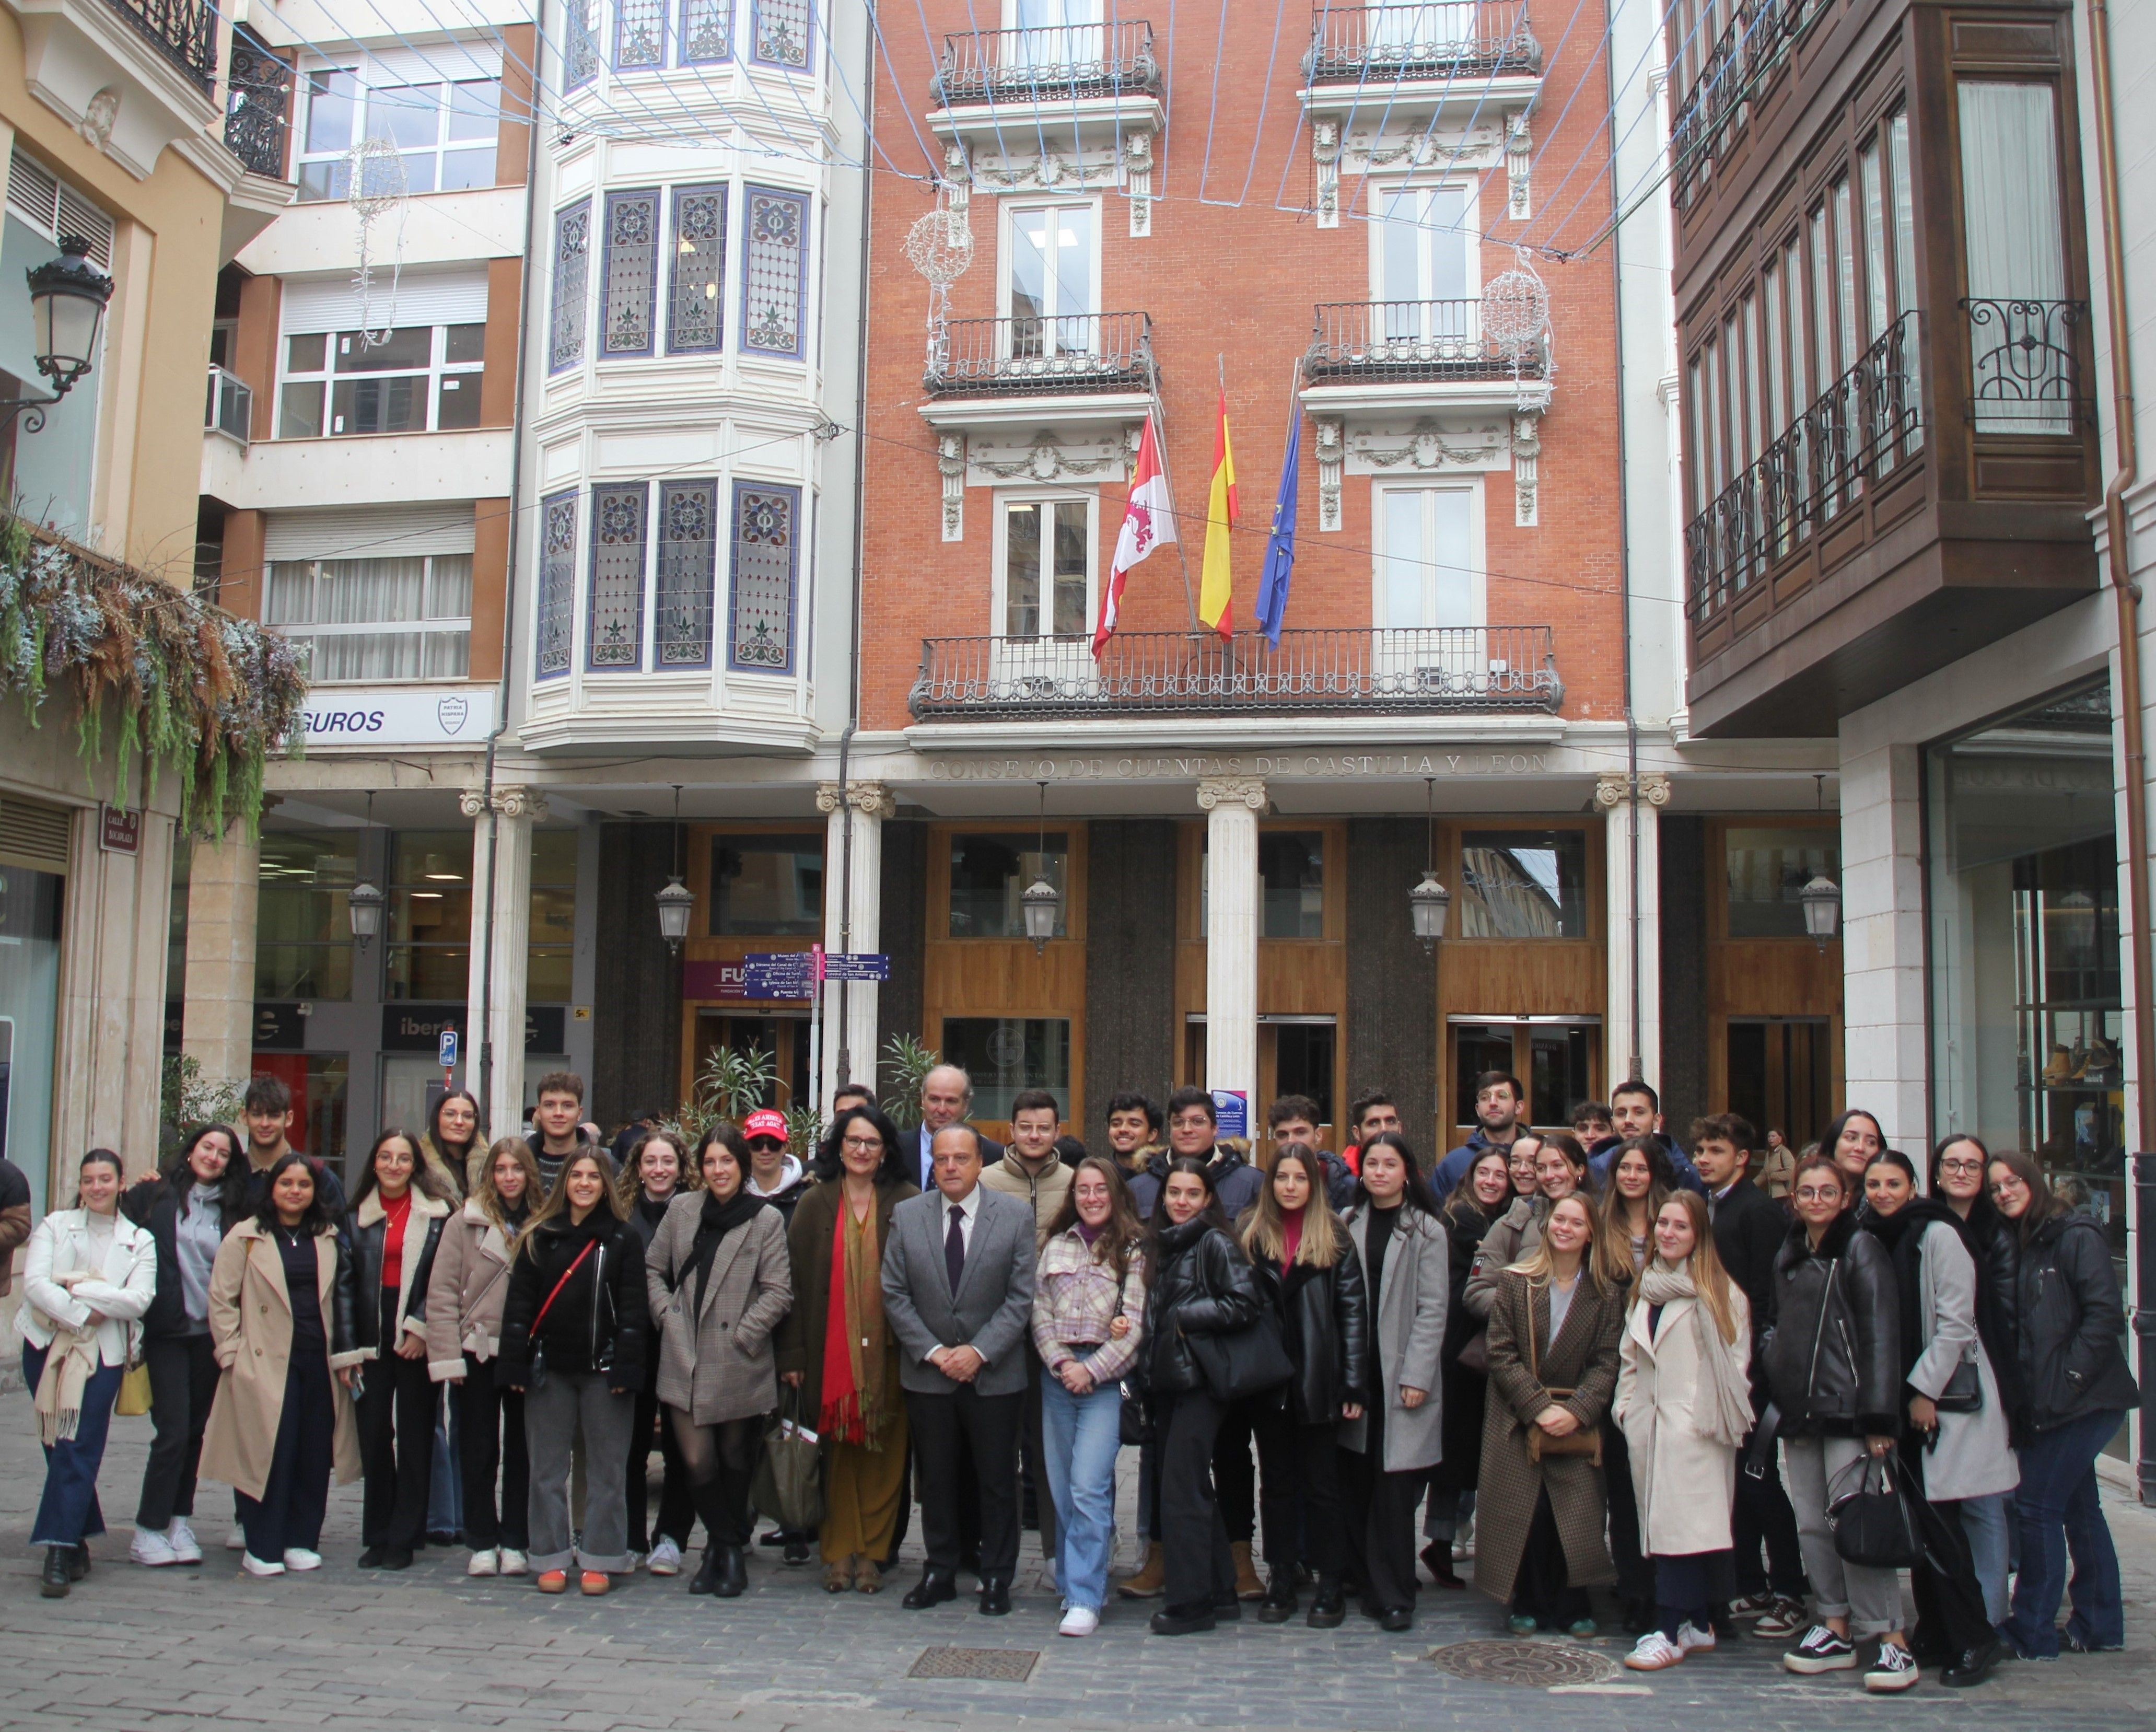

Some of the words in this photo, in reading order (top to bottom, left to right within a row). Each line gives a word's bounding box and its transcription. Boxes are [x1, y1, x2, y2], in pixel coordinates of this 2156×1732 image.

[930, 760, 1055, 778] CONSEJO
[1069, 759, 1103, 777] DE
[1117, 758, 1242, 776] CUENTAS
[1254, 757, 1291, 775] DE
[1304, 755, 1434, 774] CASTILLA
[1446, 755, 1461, 773] Y
[1474, 754, 1547, 772] LEON
[108, 816, 124, 827] CALLE
[443, 1035, 454, 1050] P
